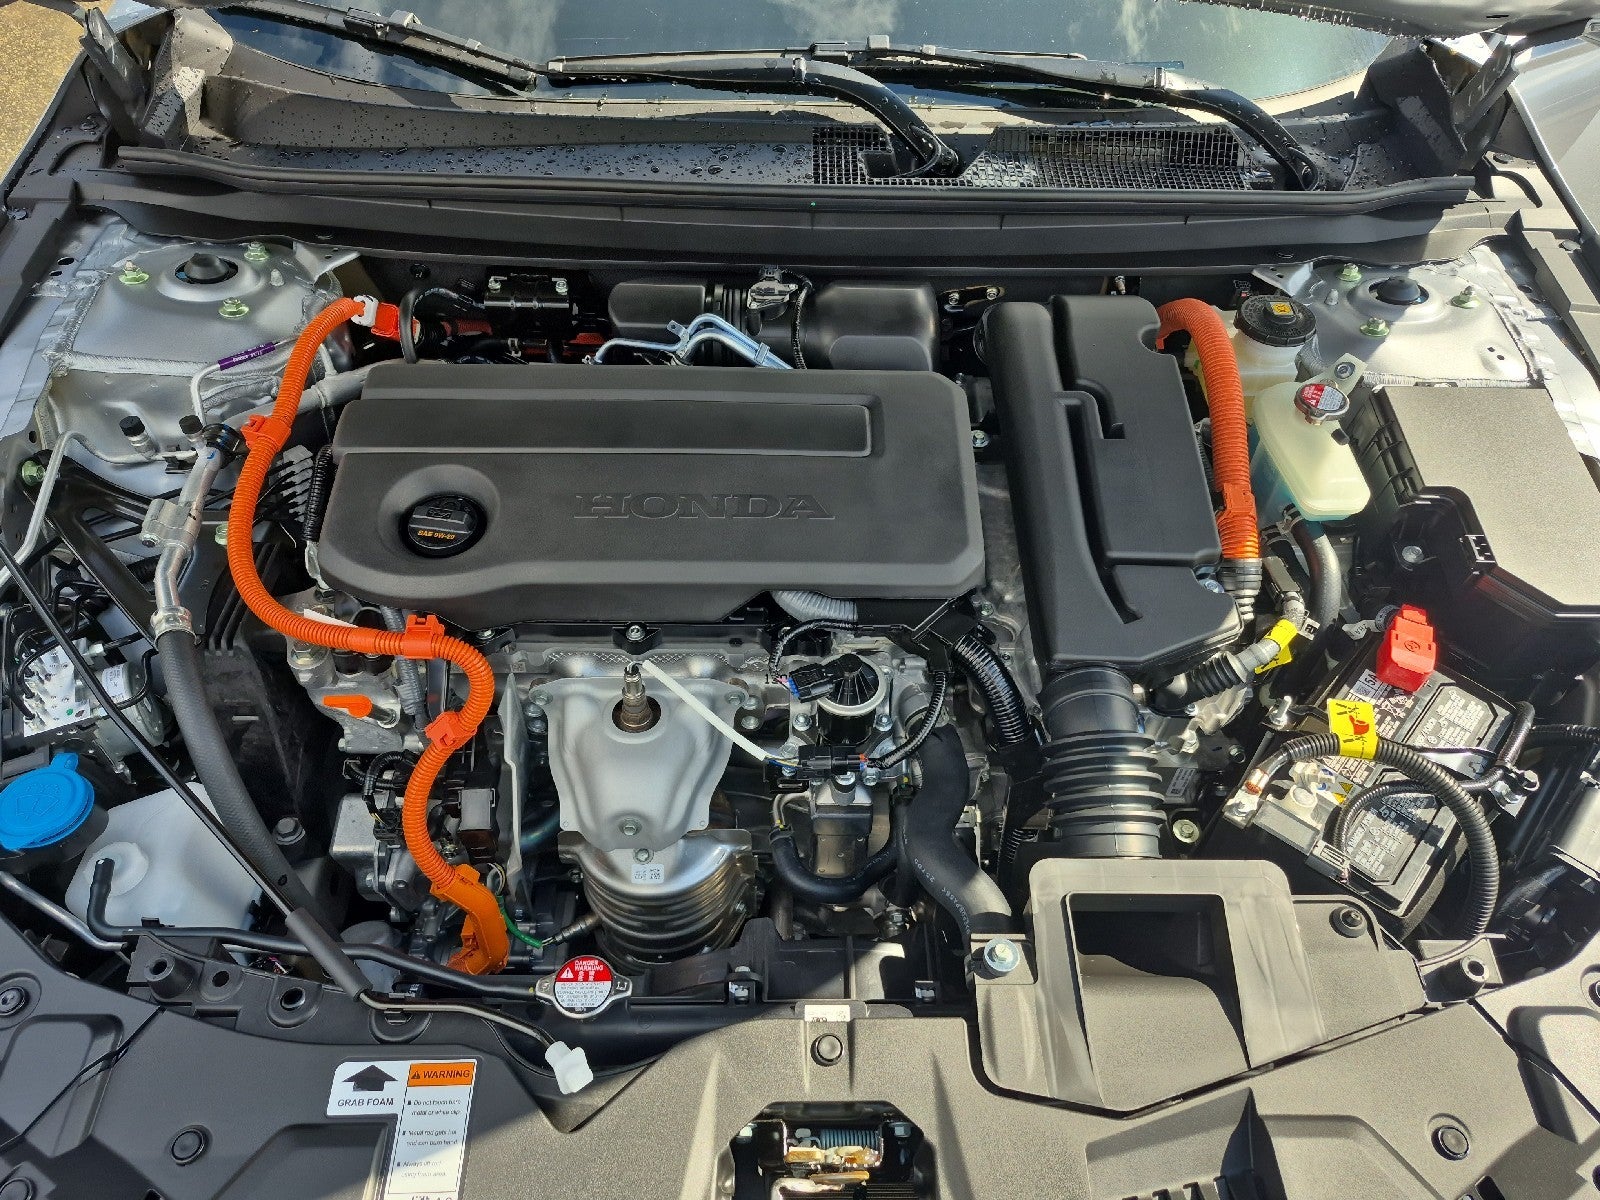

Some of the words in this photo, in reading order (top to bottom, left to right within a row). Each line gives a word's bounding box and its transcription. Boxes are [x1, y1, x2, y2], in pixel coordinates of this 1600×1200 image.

[573, 493, 835, 520] HONDA
[423, 1070, 470, 1079] WARNING
[337, 1099, 365, 1107] GRAB
[367, 1098, 394, 1106] FOAM
